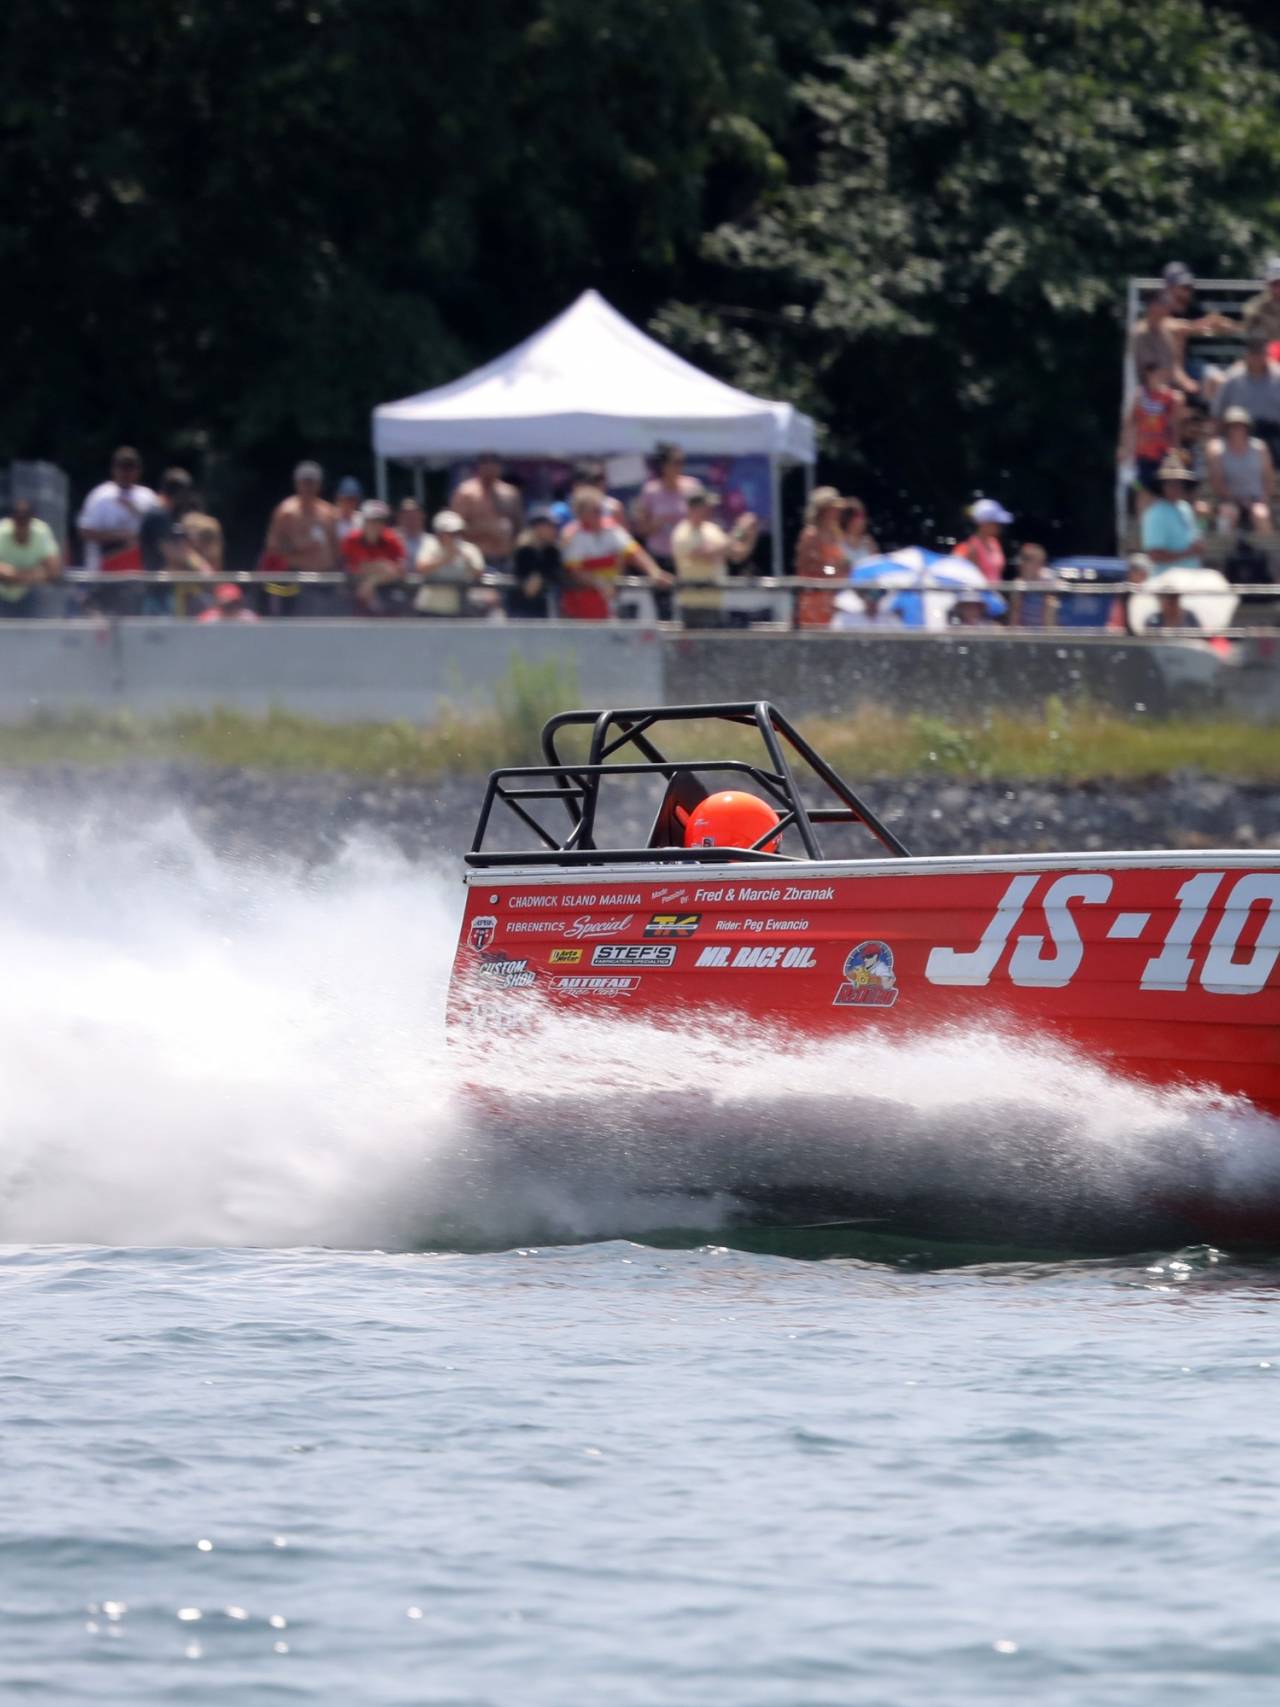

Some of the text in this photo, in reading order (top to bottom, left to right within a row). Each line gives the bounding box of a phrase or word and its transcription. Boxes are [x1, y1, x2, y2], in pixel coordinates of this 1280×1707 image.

[508, 894, 641, 909] CHADWICK ISLAND MARINA
[694, 887, 835, 902] Fred & Marcie Zbranak
[506, 914, 634, 939] FIBRENETICS Special
[716, 918, 809, 933] Rider: Peg Ewancio
[597, 946, 672, 959] STEF'S
[694, 946, 730, 967] MR.
[730, 946, 786, 967] RACE
[479, 960, 528, 978] CUSTOM
